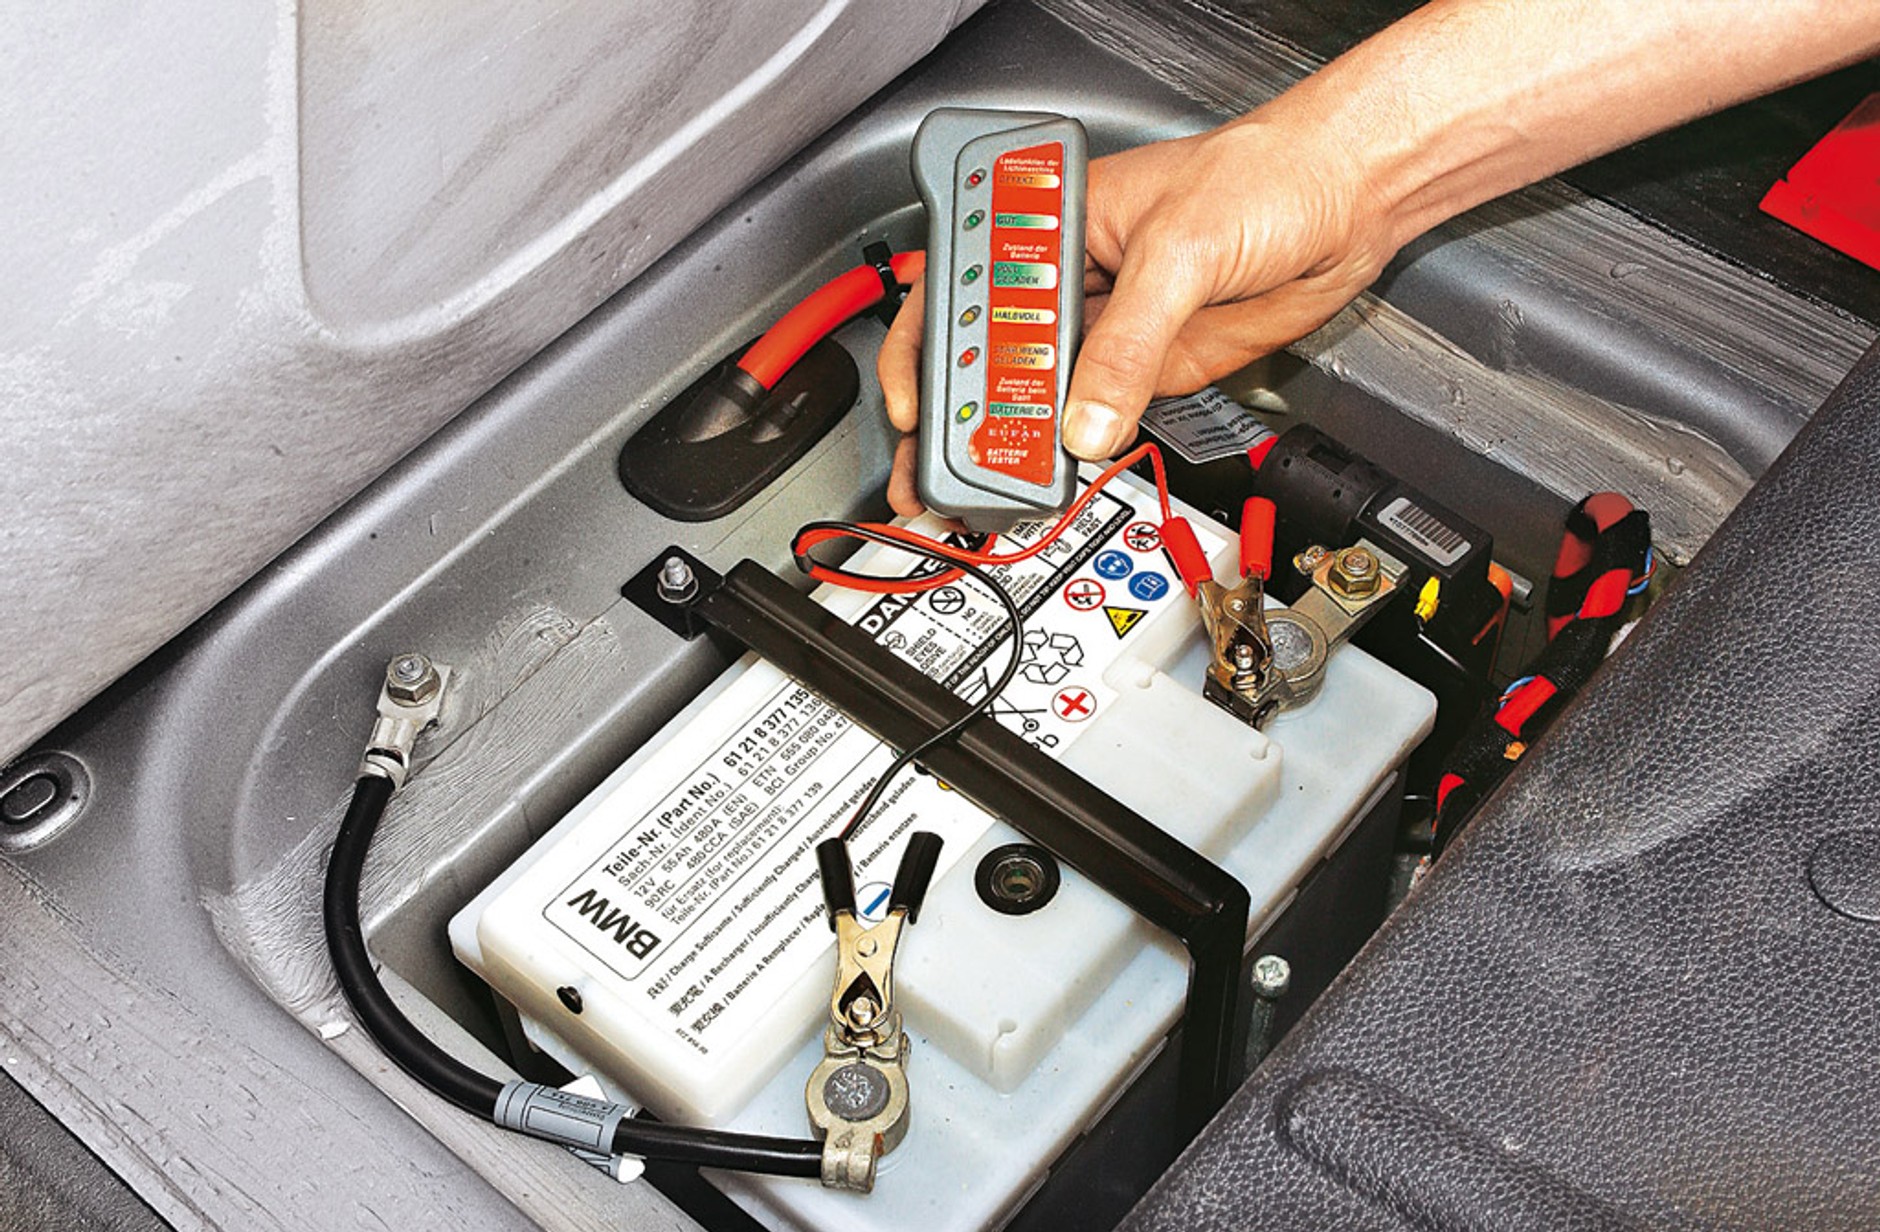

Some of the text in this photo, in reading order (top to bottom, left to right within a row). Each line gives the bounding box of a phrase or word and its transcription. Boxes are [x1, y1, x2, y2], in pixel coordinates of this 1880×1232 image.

[999, 175, 1035, 185] DEFEKT
[998, 217, 1017, 225] GUT
[1002, 242, 1034, 252] Zustand
[1009, 251, 1041, 260] Batterie
[996, 276, 1040, 285] GELADEN
[993, 311, 1042, 322] HALBVOLL
[994, 356, 1037, 365] GELADEN
[1020, 347, 1050, 356] WENIG
[996, 386, 1026, 394] Batterie
[999, 377, 1045, 387] Zustand der
[991, 405, 1050, 416] BATTERIE OK
[986, 448, 1029, 458] BATTERIE
[987, 457, 1021, 465] TESTER
[1073, 511, 1094, 532] HELP
[1081, 517, 1102, 537] FAST
[961, 607, 977, 621] NO
[905, 628, 937, 657] SHIELD
[913, 641, 938, 663] EYES
[920, 646, 947, 673] OSIVE
[602, 688, 809, 877] Teile-Nr. (Part No.) 61 21 8 377 135
[729, 803, 759, 829] (SAE)
[764, 777, 785, 796] BCI
[784, 747, 818, 775] Group
[815, 732, 836, 746] No.
[618, 696, 824, 886] Sach-Nr. (Ident No.) 61 21 8 377 136
[634, 878, 655, 897] 12V
[723, 794, 747, 816] (EN)
[752, 766, 777, 787] ETN
[780, 743, 801, 761] 555
[817, 706, 839, 726] 048
[670, 782, 823, 925] Teile-Nr. (Part No.) 61 21 8 377 139
[669, 950, 698, 976] Charge
[694, 916, 733, 952] Suffisante
[734, 874, 778, 913] Sufficiently
[773, 846, 805, 875] Charged
[806, 801, 851, 845] Ausreichend
[848, 777, 876, 806] geladen
[710, 939, 749, 976] Recharger
[750, 892, 799, 936] Insufficiently
[888, 777, 916, 805] geladen
[661, 904, 677, 919] für
[675, 878, 707, 905] Ersatz
[705, 861, 723, 878] (for
[725, 971, 758, 1000] Batterie
[762, 927, 802, 965] Remplacer
[859, 841, 890, 868] Batterie
[888, 813, 918, 841] ersetzen
[567, 889, 662, 961] BMW
